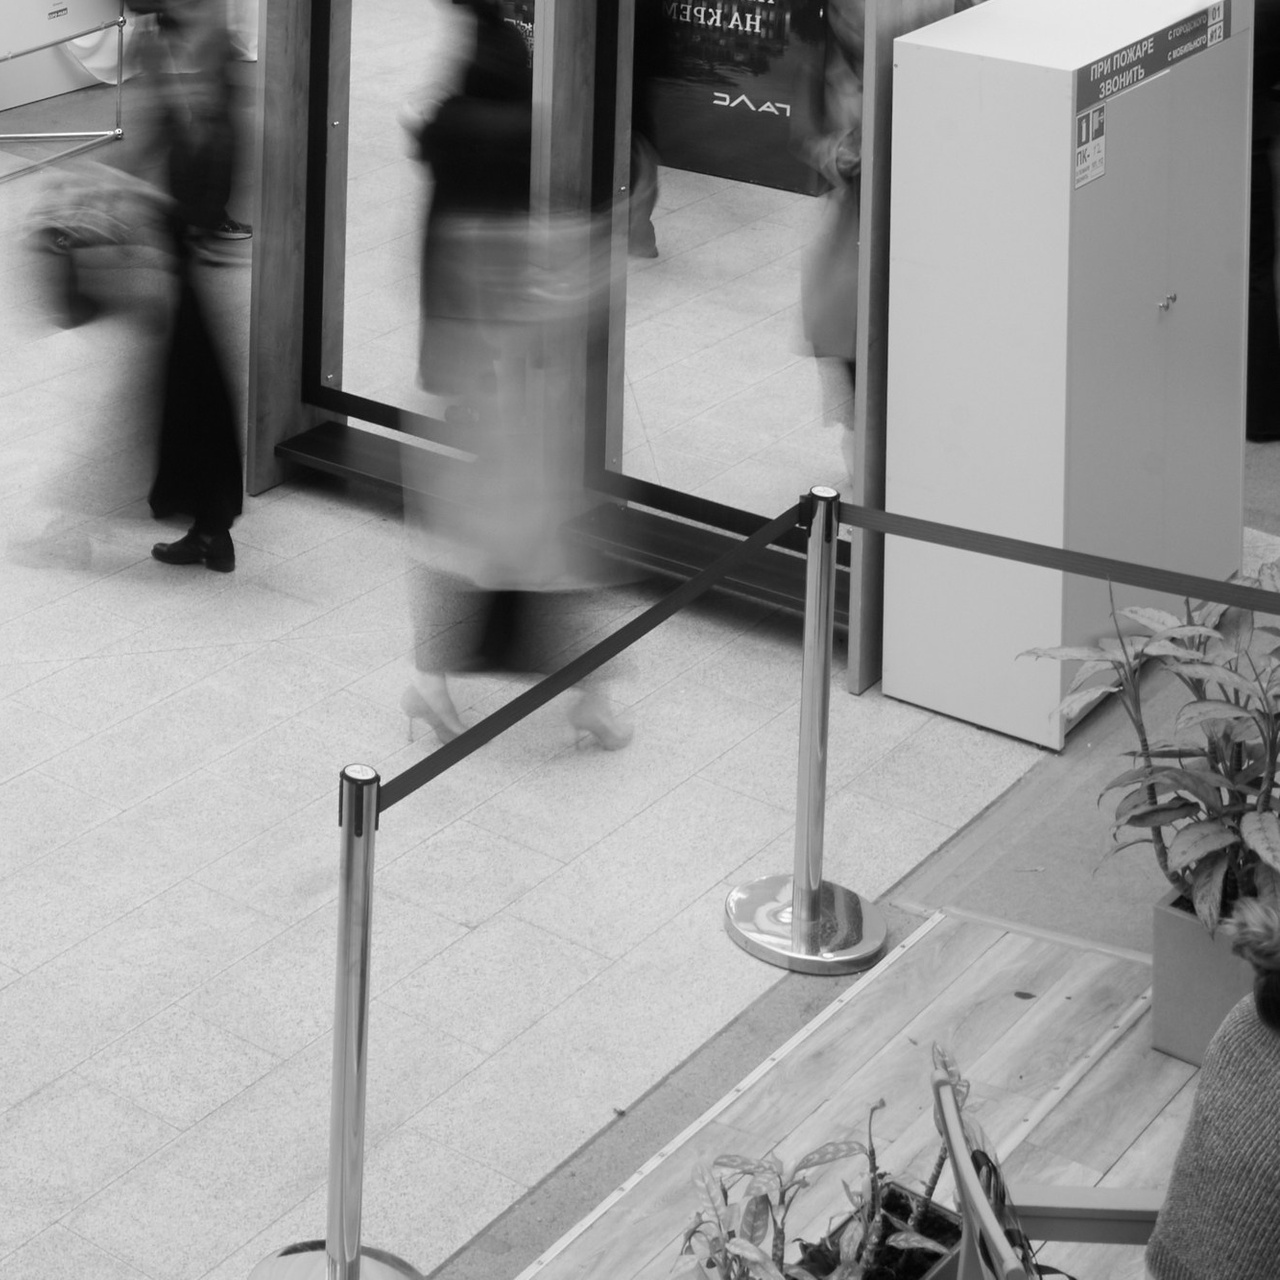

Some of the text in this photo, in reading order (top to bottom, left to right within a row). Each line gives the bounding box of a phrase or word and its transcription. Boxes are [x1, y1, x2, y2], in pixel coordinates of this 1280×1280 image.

[1212, 5, 1221, 21] 01
[1090, 37, 1155, 82] ПРИ ПОЖАРЕ
[1099, 64, 1145, 99] ЗВОНИТЬ
